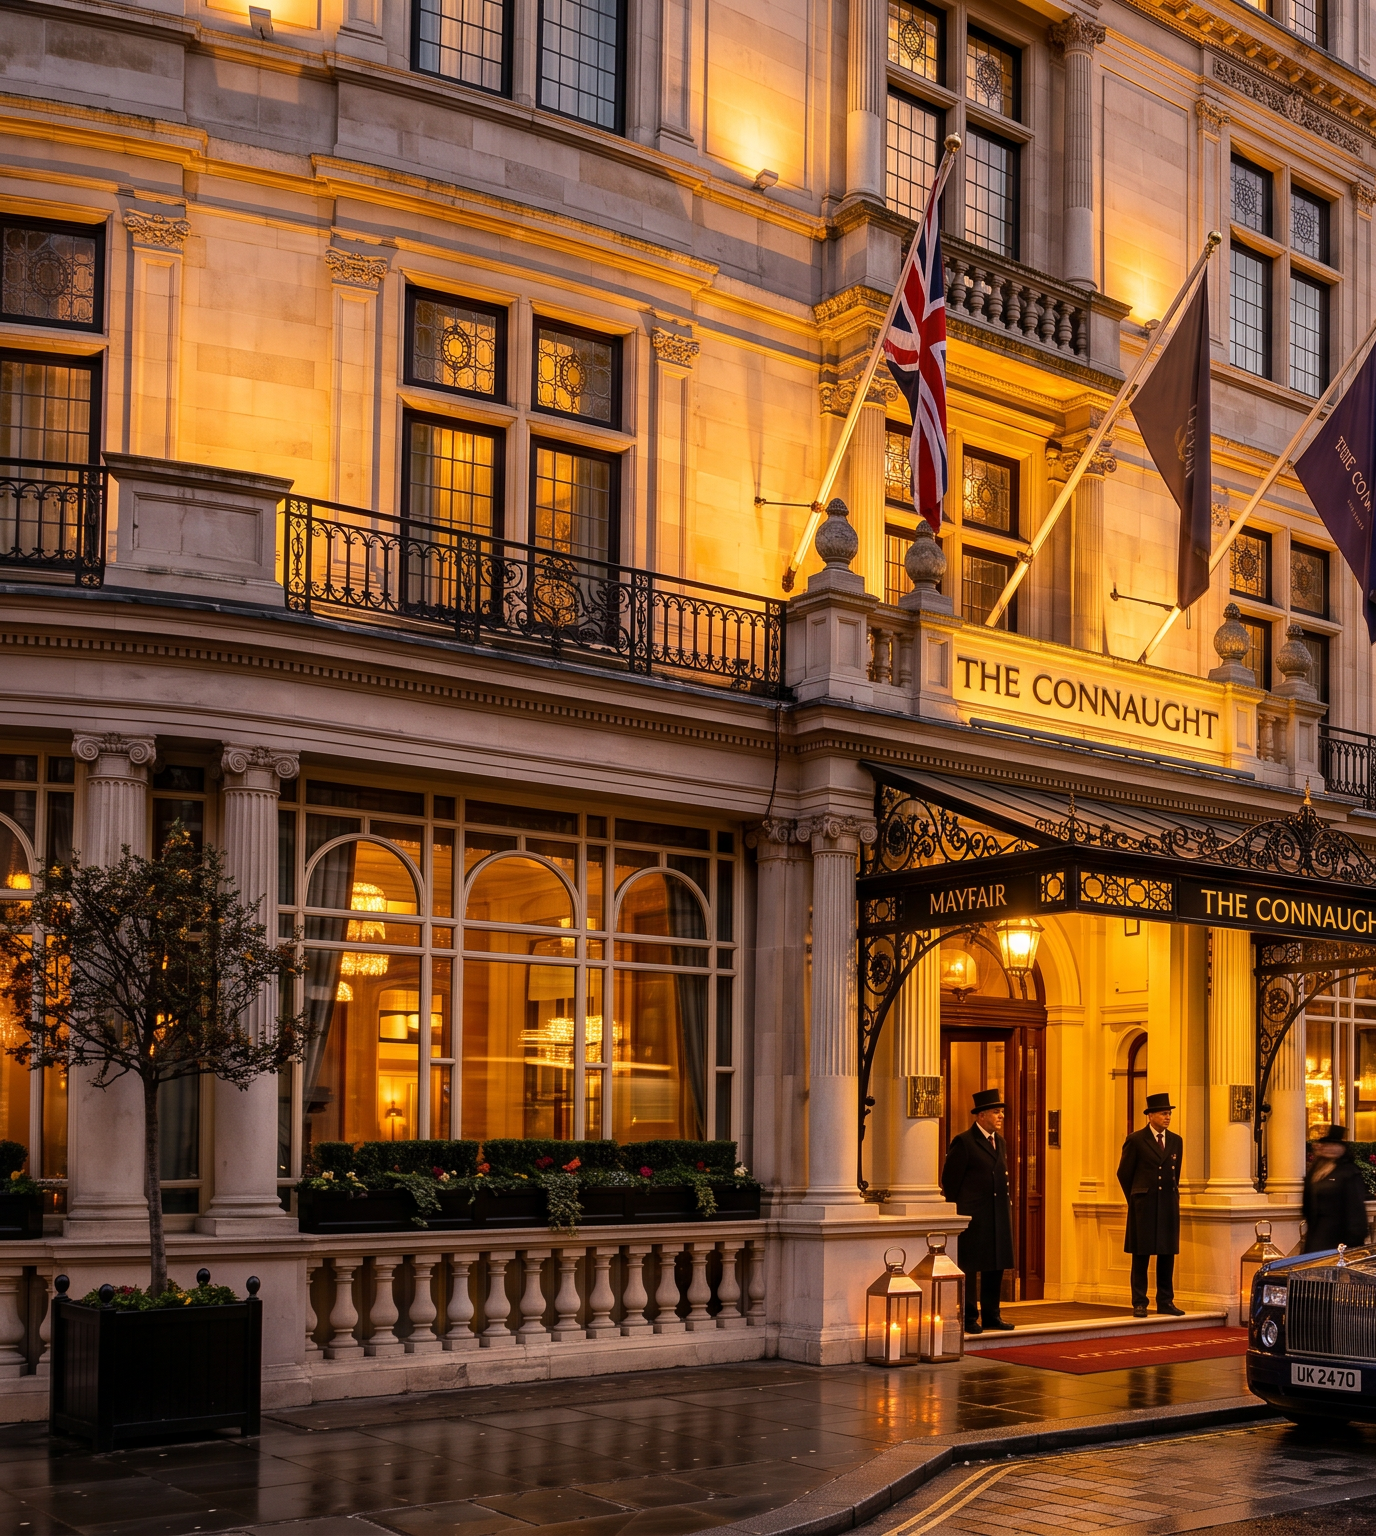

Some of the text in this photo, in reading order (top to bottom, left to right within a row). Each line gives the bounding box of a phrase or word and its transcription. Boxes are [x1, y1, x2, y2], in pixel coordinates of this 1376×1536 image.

[957, 654, 1219, 740] THE CONNAUGHT
[930, 884, 1008, 915] MAYFAIR
[1201, 889, 1248, 919] THE
[1297, 1366, 1355, 1388] UK 2470
